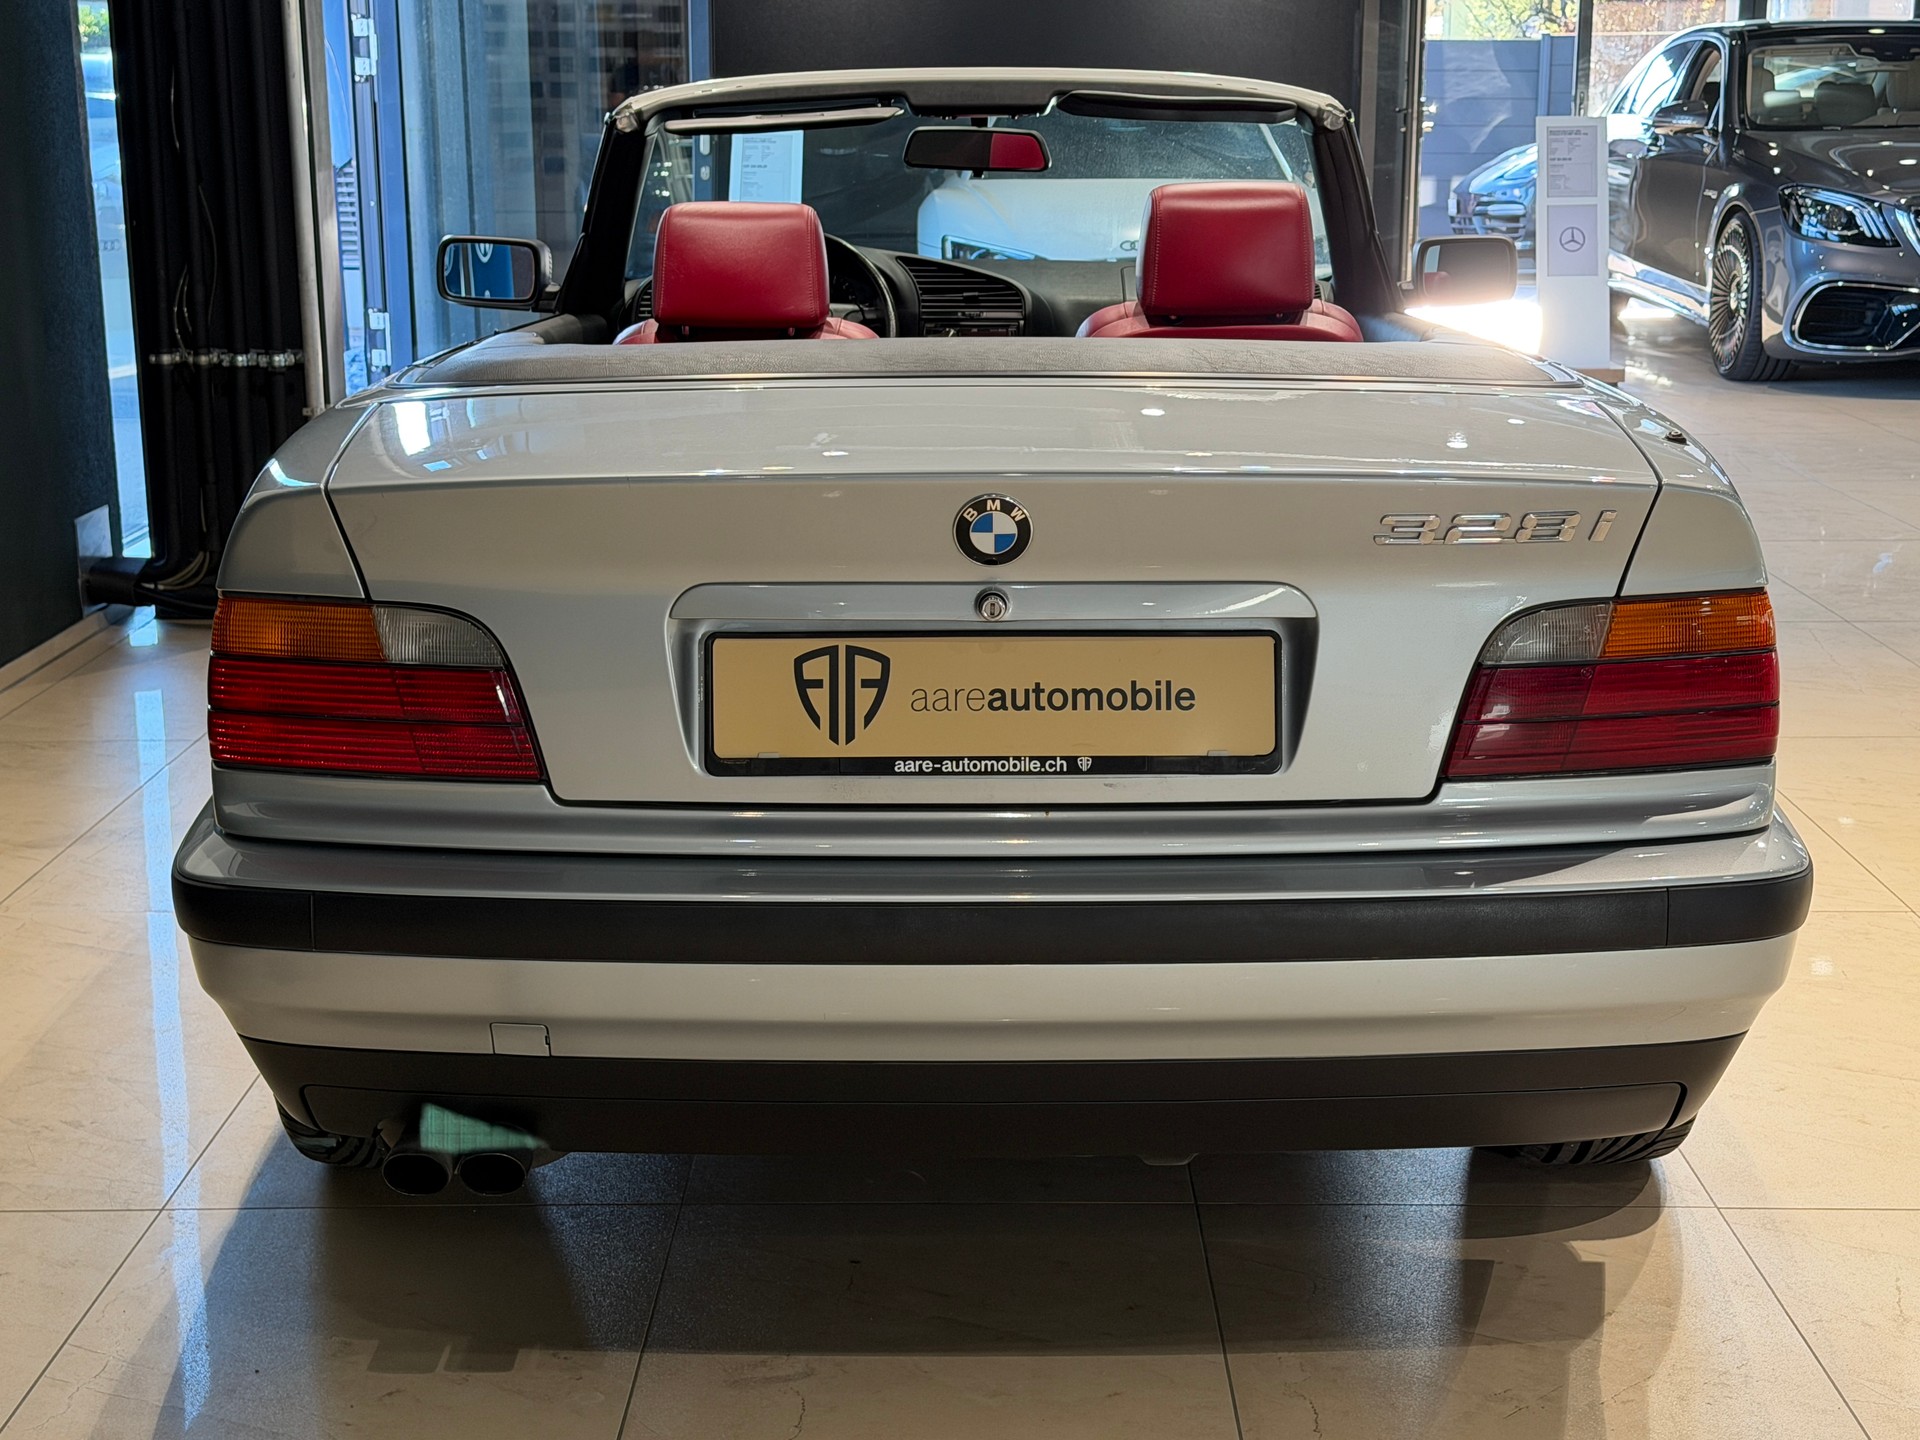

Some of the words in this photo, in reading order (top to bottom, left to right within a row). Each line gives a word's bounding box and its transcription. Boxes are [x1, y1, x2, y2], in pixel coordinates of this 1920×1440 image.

[962, 499, 1026, 522] BMW
[1373, 510, 1618, 545] 328i
[910, 680, 1196, 712] aareautomobile
[894, 756, 1068, 773] aare-automobile.ch
